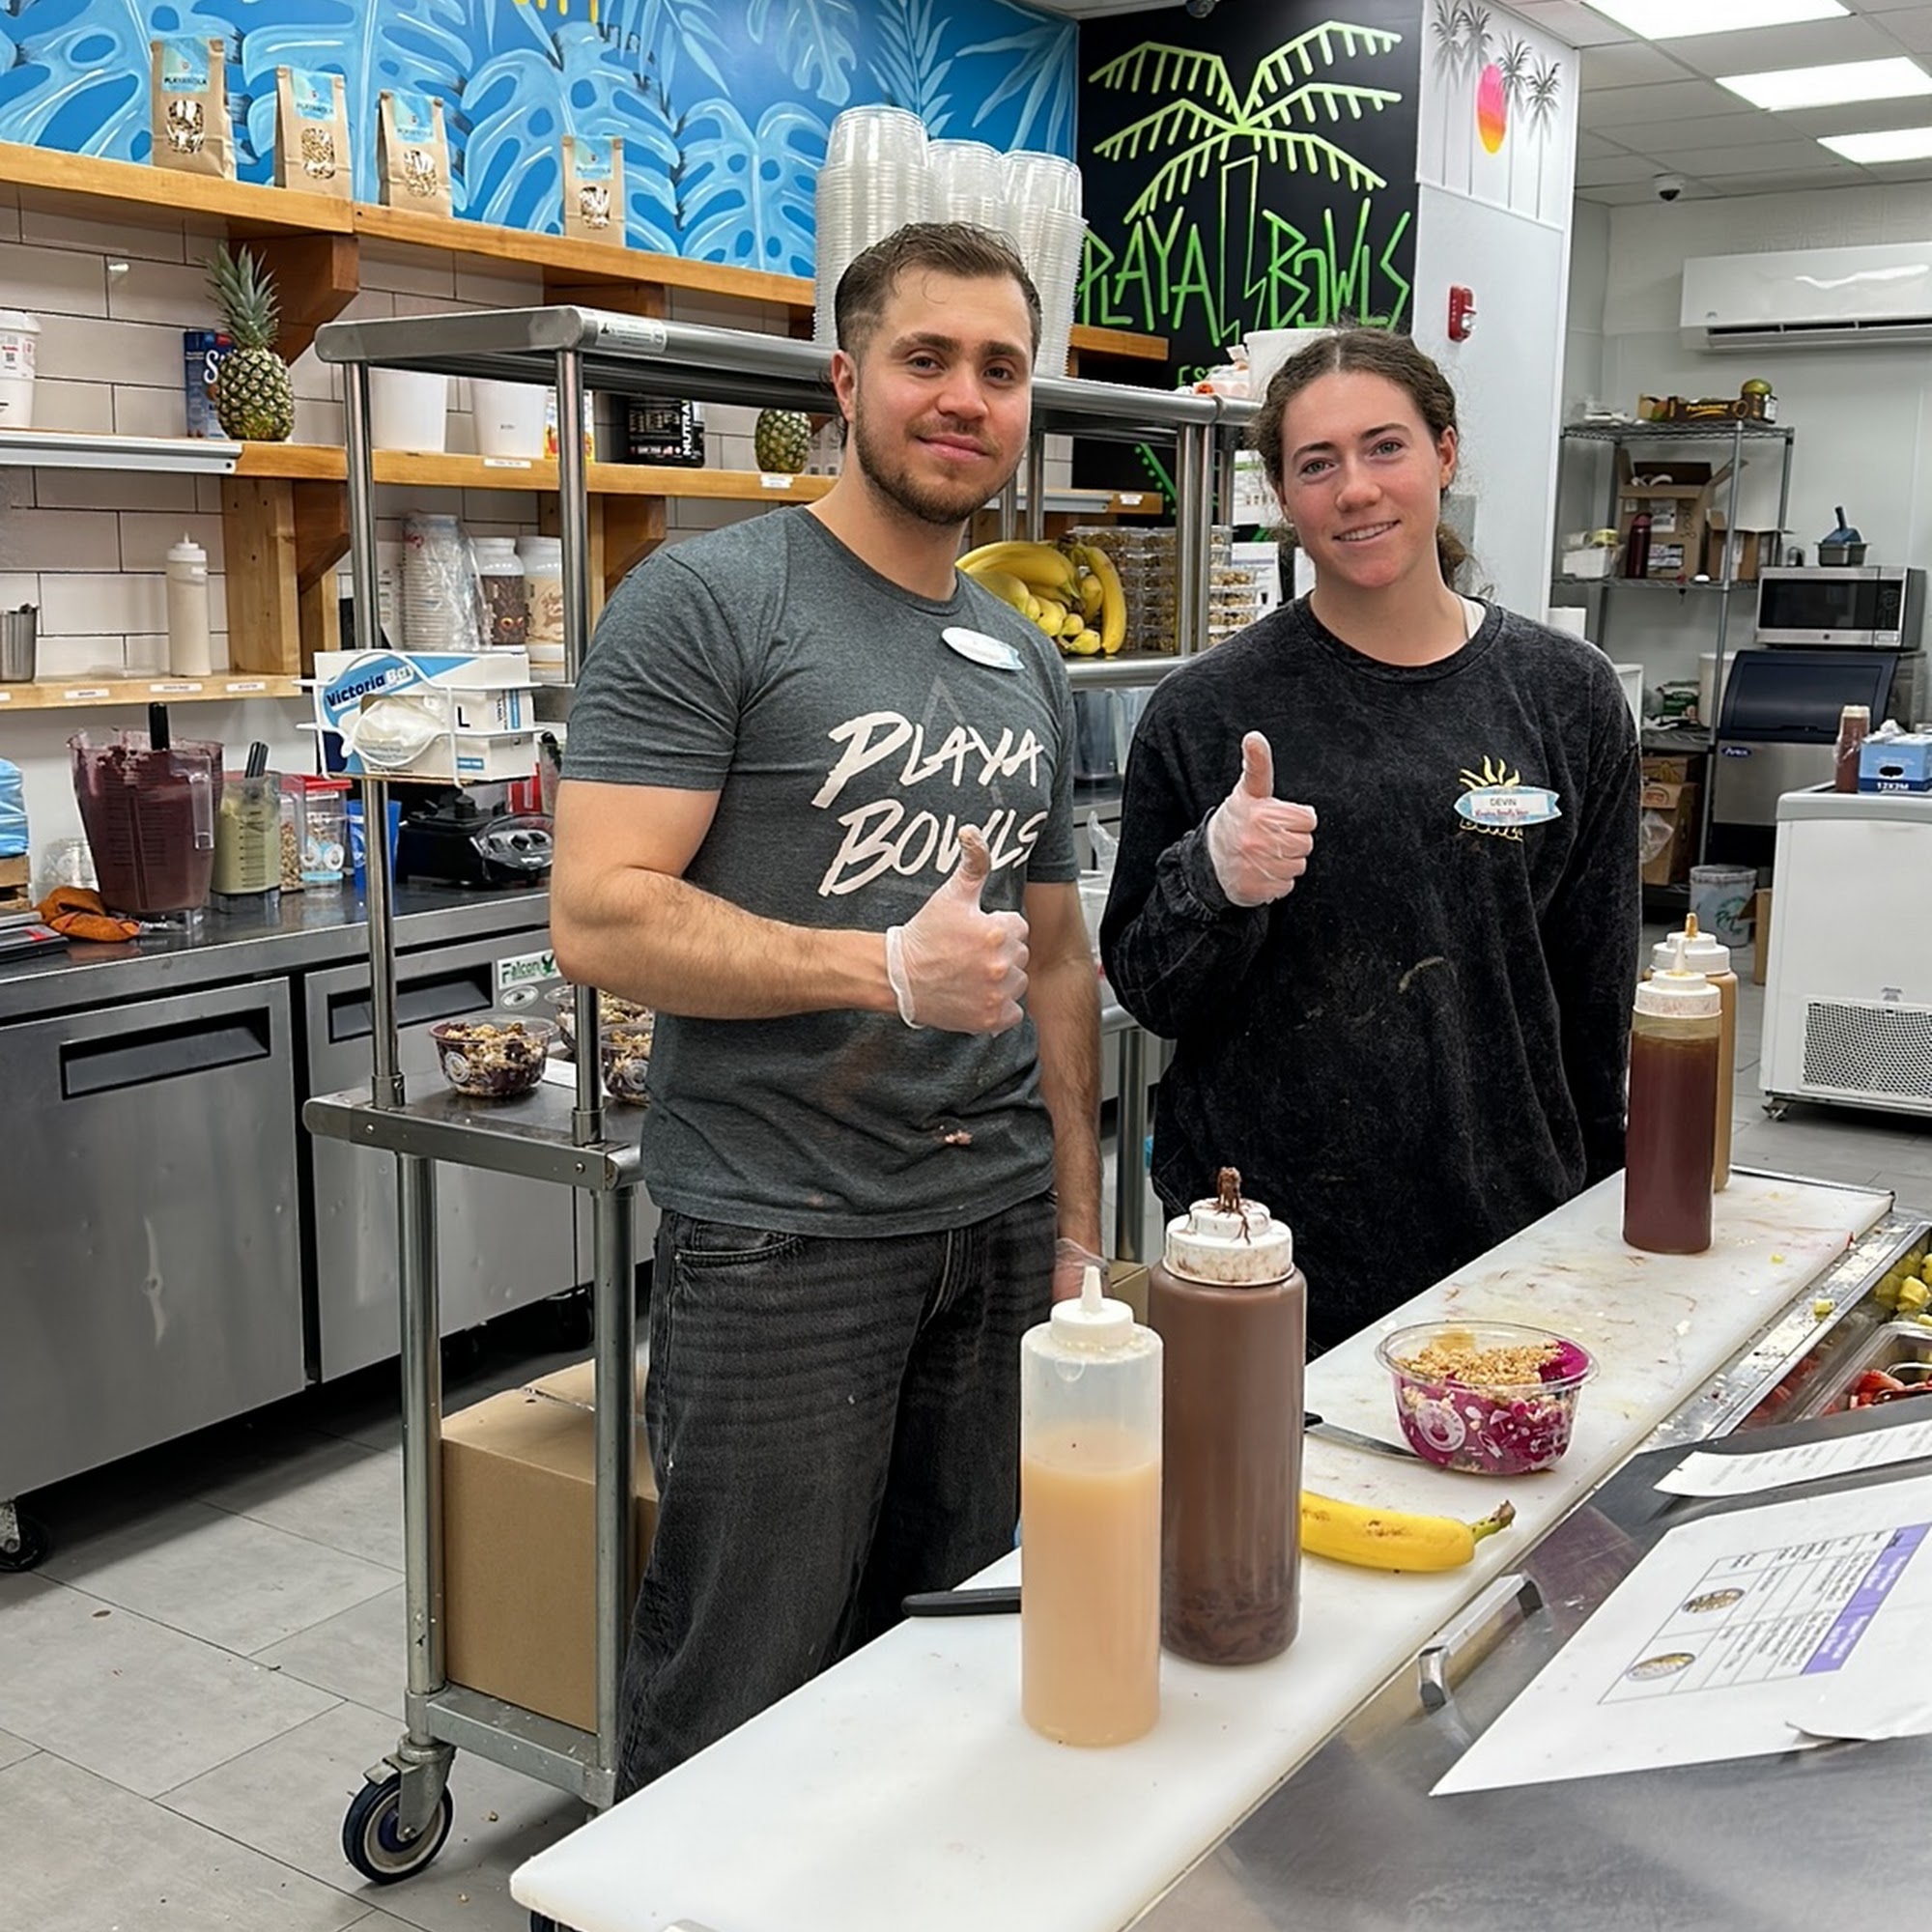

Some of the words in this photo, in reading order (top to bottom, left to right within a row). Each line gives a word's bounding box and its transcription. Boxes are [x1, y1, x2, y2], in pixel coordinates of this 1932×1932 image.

[1077, 205, 1220, 347] PLAYA
[1262, 197, 1411, 330] BOWLS
[326, 673, 386, 707] Victoria
[455, 706, 470, 728] L
[810, 710, 1044, 810] PLAYA
